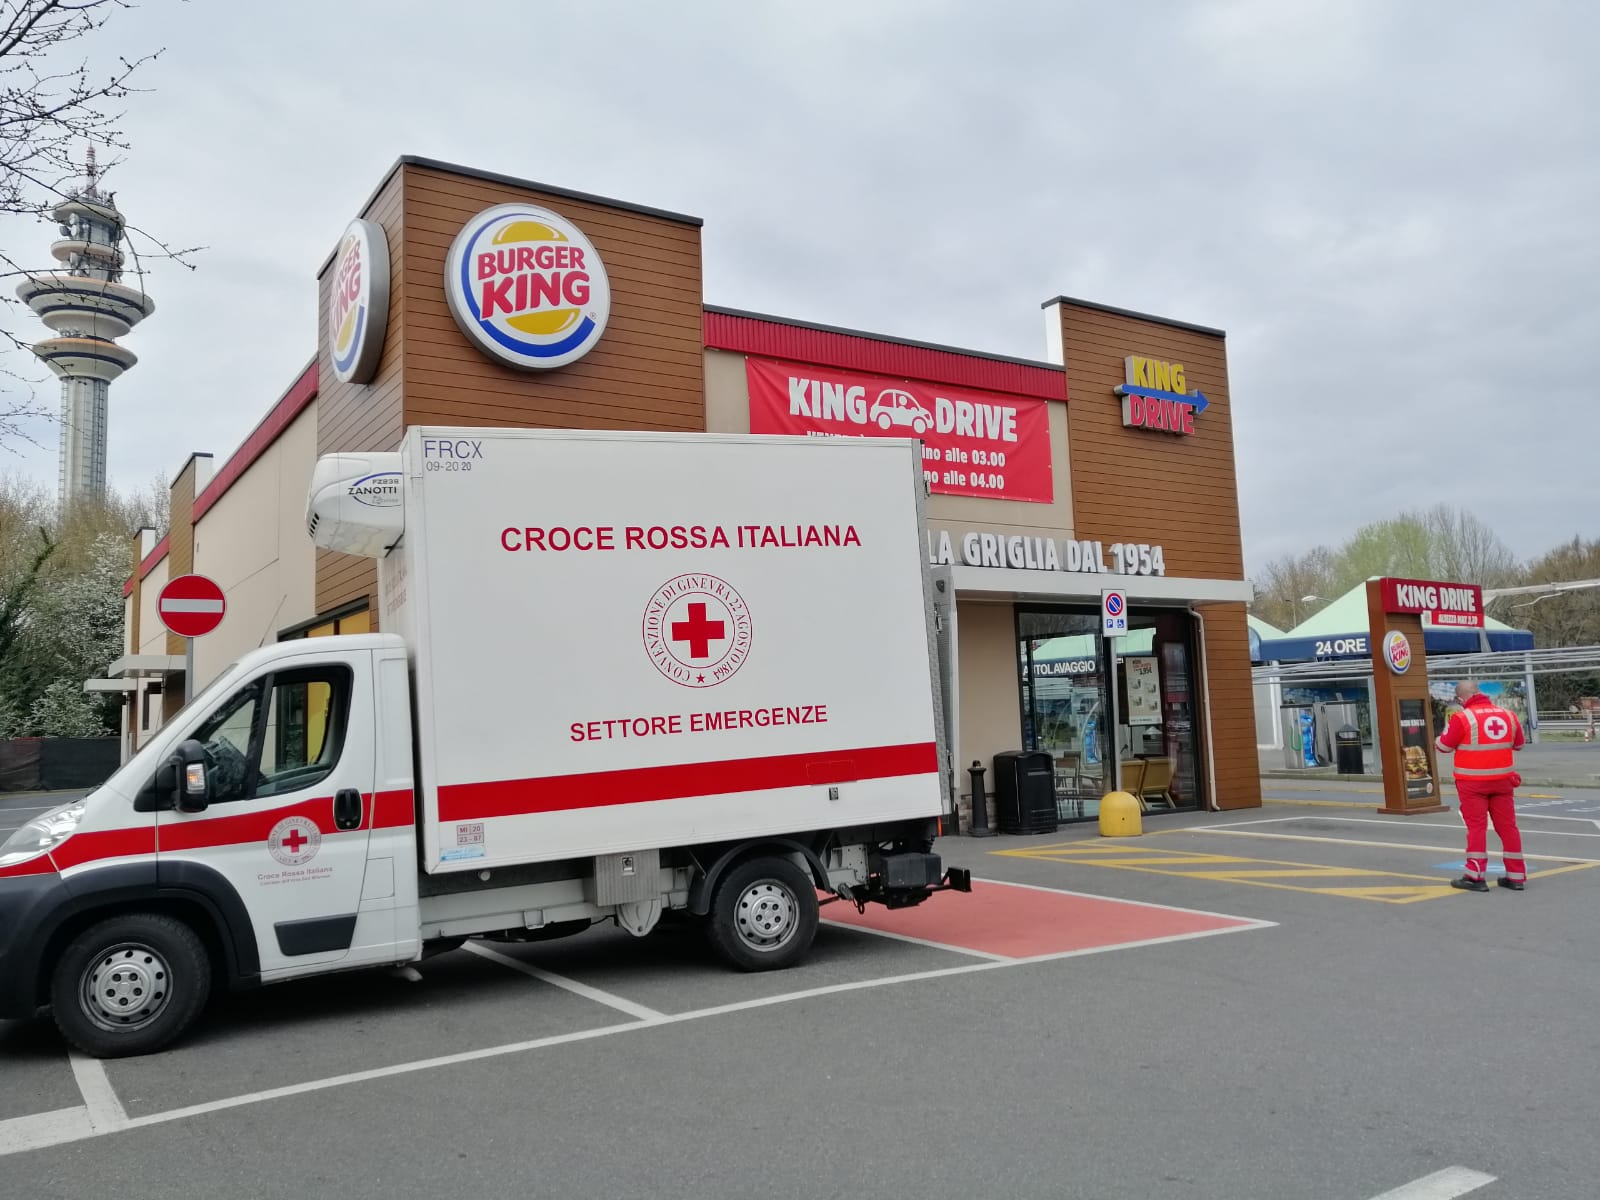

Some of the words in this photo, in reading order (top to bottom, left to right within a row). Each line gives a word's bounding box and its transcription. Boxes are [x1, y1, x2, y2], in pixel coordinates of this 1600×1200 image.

[478, 245, 586, 280] BURGER
[482, 271, 590, 319] KING
[1131, 355, 1187, 395] KING
[788, 376, 867, 425] KING
[935, 397, 1018, 442] DRIVE
[1128, 394, 1195, 434] DRIVE
[424, 440, 483, 459] FRCX
[921, 443, 941, 461] ino
[945, 447, 968, 464] alle
[972, 449, 1006, 467] 03.00
[348, 486, 397, 495] ZANOTTI
[923, 470, 939, 484] no
[943, 470, 966, 486] alle
[970, 472, 1005, 490] 04.00
[501, 526, 615, 552] CROCE
[625, 525, 730, 550] ROSSA
[737, 525, 862, 548] ITALIANA
[962, 532, 1060, 571] GRIGLIA
[1066, 540, 1108, 573] DAL
[1110, 542, 1166, 576] 1954
[662, 585, 677, 601] DI
[677, 576, 731, 601] GINEVRA
[1396, 583, 1438, 610] KING
[1439, 586, 1476, 612] DRIVE
[728, 598, 742, 612] 22
[647, 599, 691, 682] CONVENZIONE
[731, 614, 749, 664] AGOSTO
[1315, 640, 1333, 655] 24
[1334, 637, 1367, 654] ORE
[570, 715, 683, 742] SETTORE
[690, 704, 829, 732] EMERGENZE
